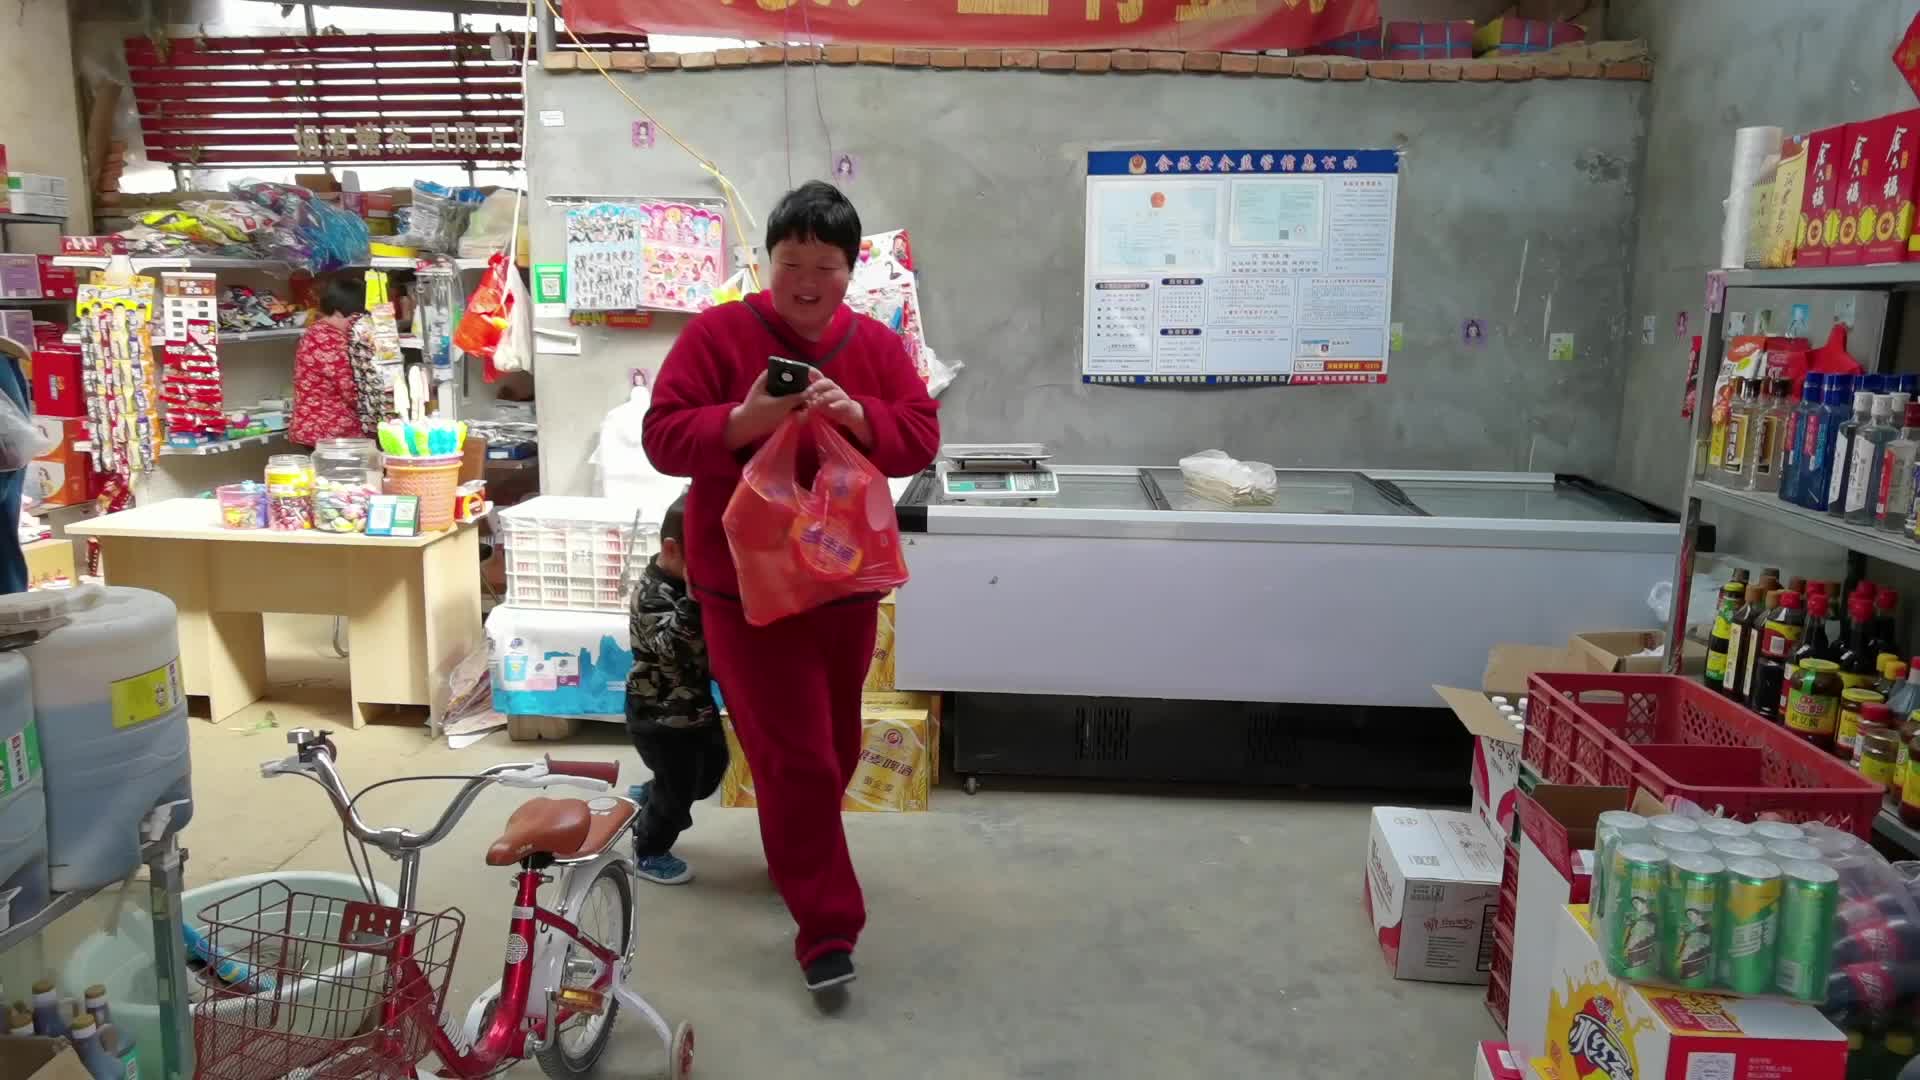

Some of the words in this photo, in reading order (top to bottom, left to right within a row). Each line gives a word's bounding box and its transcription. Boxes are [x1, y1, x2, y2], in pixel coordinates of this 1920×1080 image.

[1155, 154, 1358, 171] 食品安全监管信息公示
